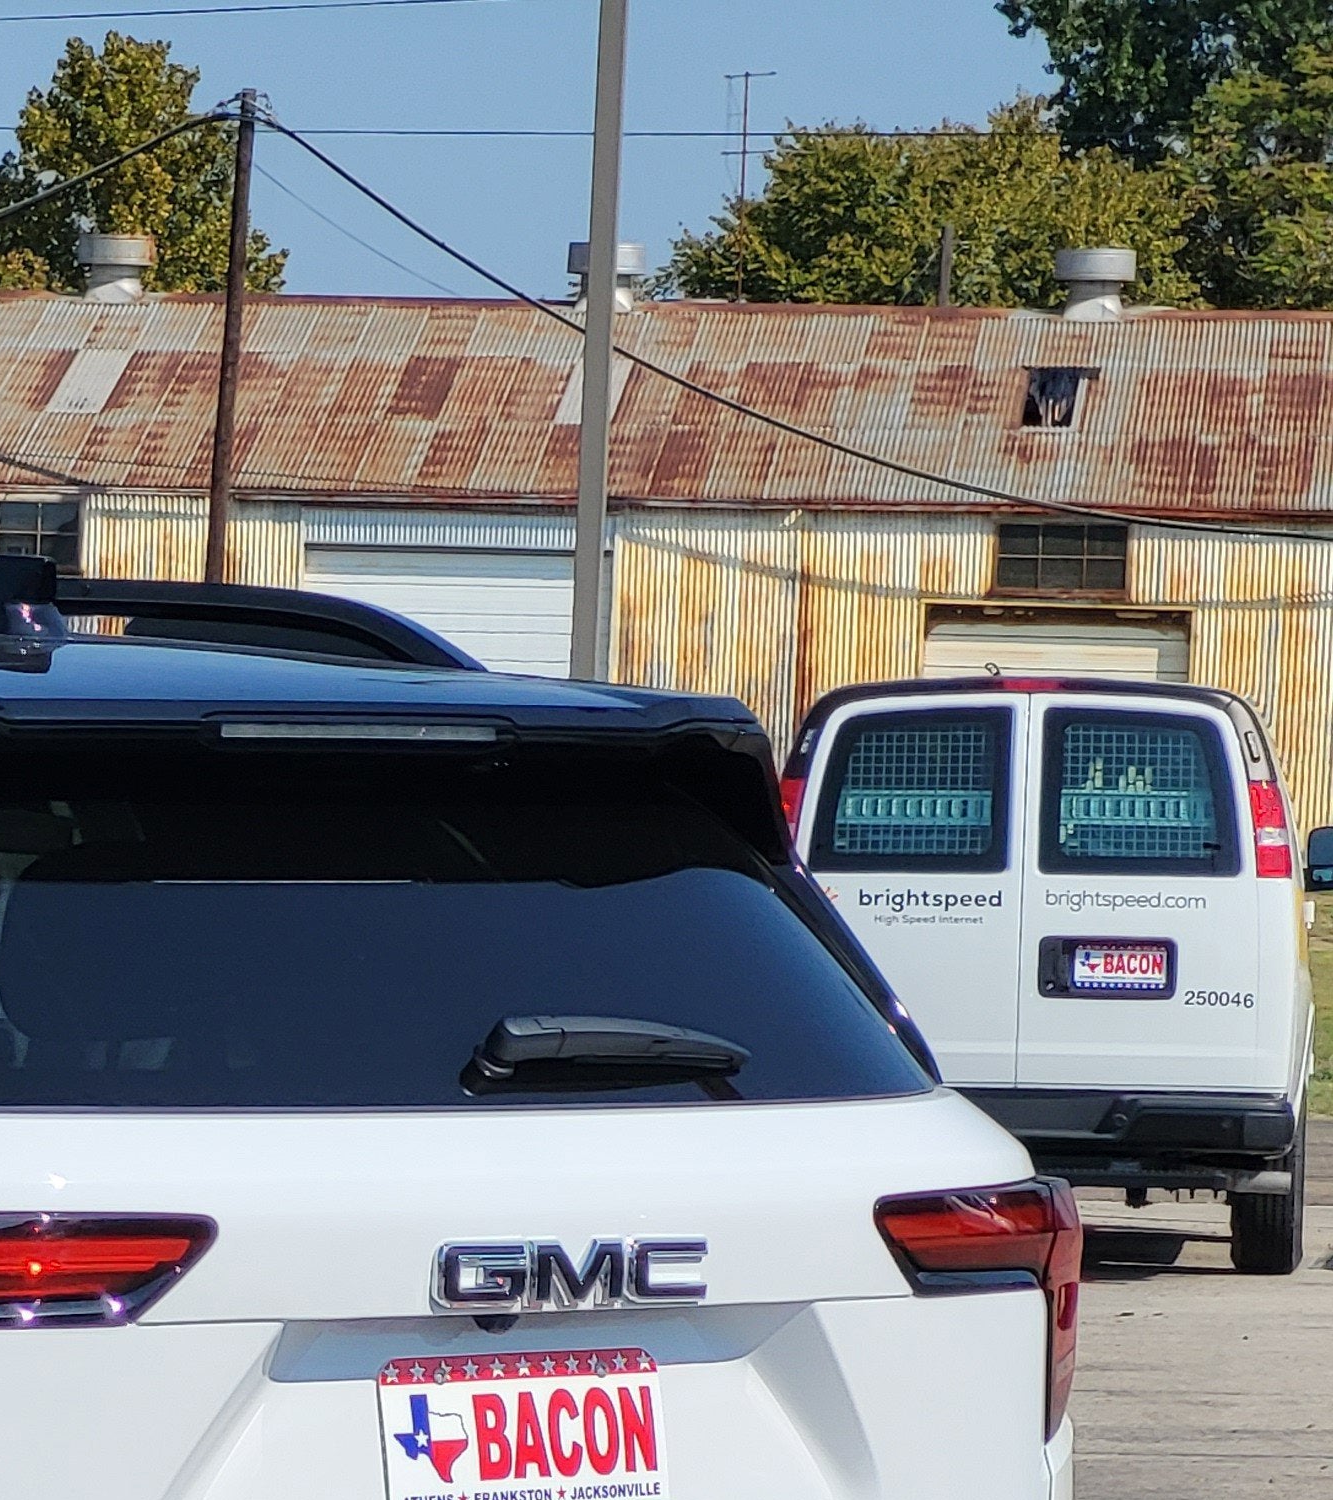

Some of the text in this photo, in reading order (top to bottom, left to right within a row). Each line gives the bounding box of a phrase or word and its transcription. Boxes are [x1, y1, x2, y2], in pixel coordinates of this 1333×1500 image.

[858, 888, 1003, 913] brightspeed
[1045, 889, 1207, 912] brightspeed.com
[874, 914, 984, 927] High Speed Internet
[1103, 953, 1164, 975] BACON
[1184, 990, 1255, 1009] 250046
[430, 1234, 710, 1313] GMC
[471, 1385, 659, 1482] BACON
[570, 1482, 661, 1500] JACKSONVILLE
